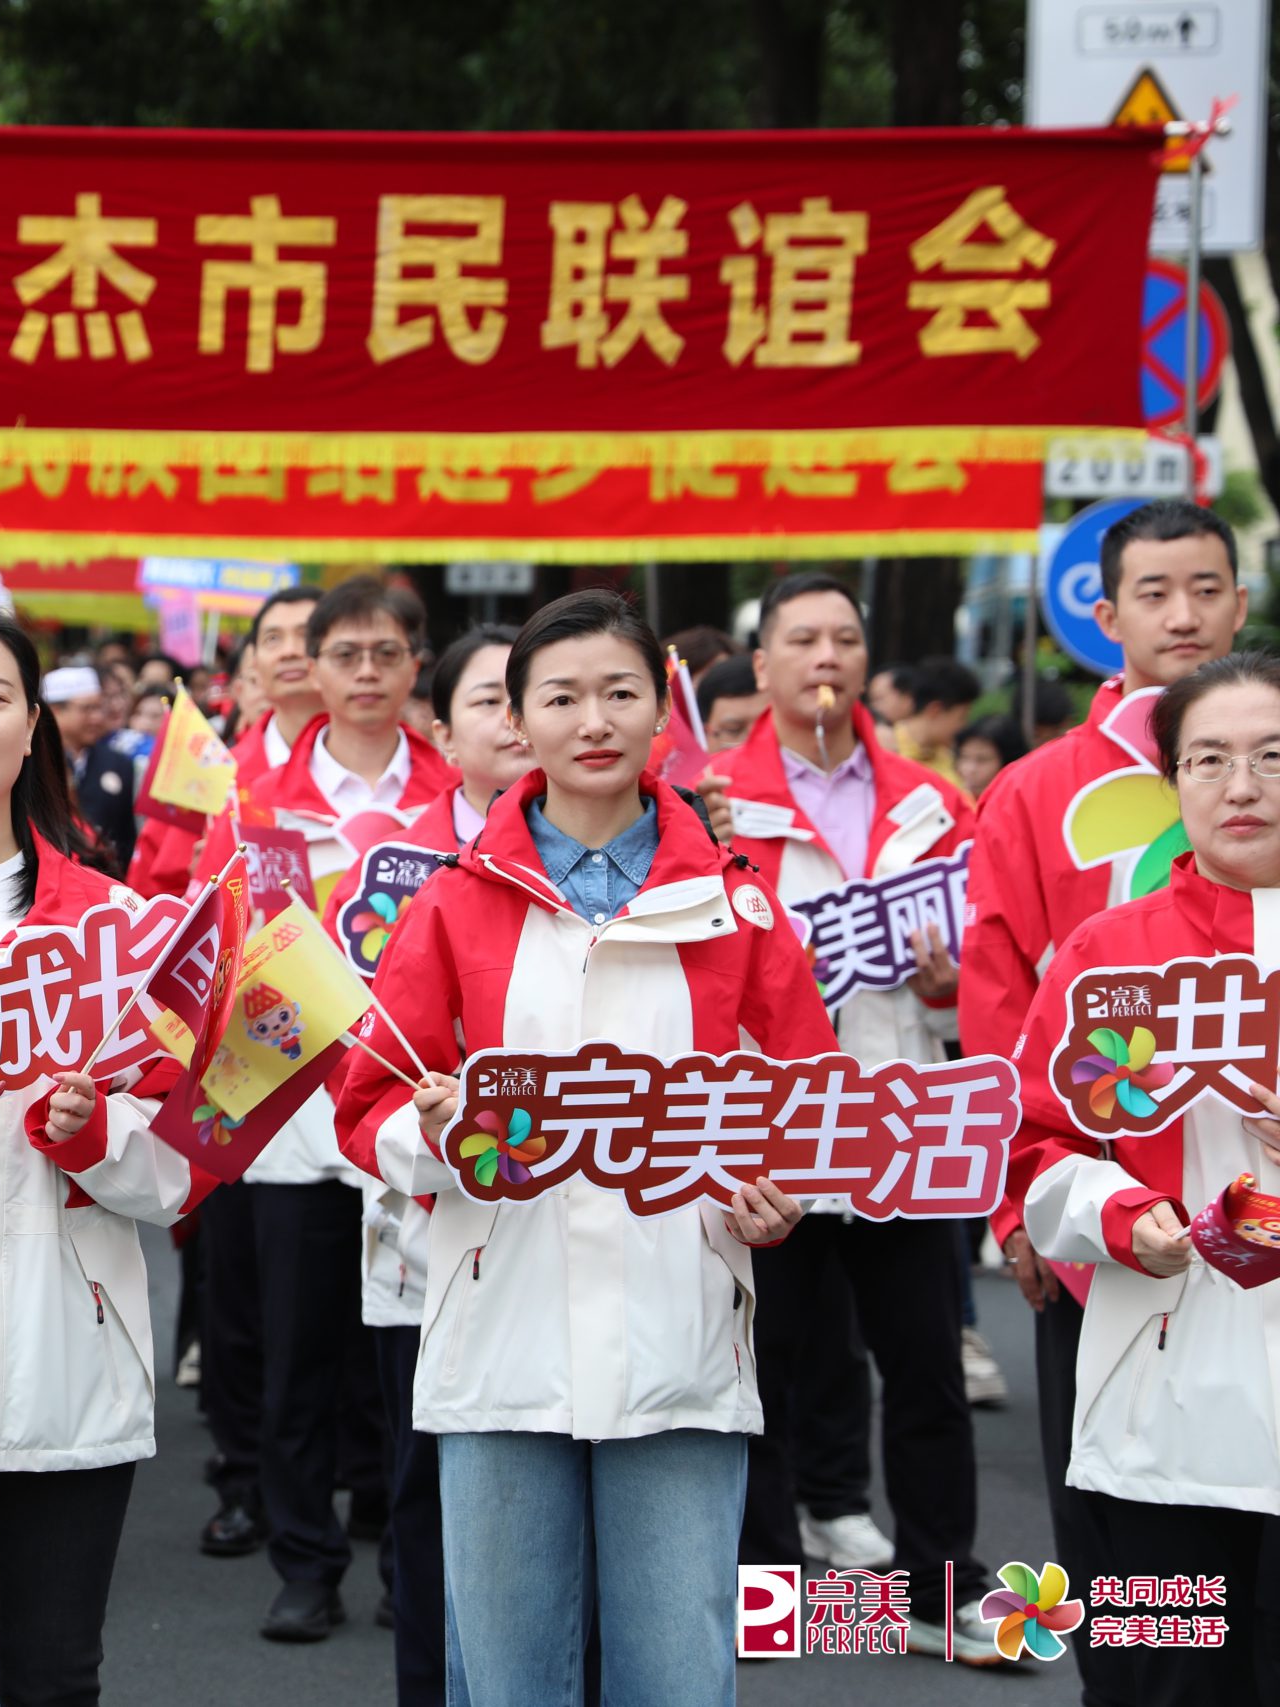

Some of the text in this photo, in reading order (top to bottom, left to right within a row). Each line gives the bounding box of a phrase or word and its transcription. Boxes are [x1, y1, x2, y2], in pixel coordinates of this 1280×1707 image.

[261, 847, 304, 878] 完美
[813, 868, 968, 999] 美丽
[1111, 985, 1151, 1006] 完美
[1112, 1005, 1152, 1017] PERFECT
[501, 1067, 538, 1086] 完美
[501, 1086, 537, 1096] PERFECT
[528, 1058, 1002, 1204] 完美生活
